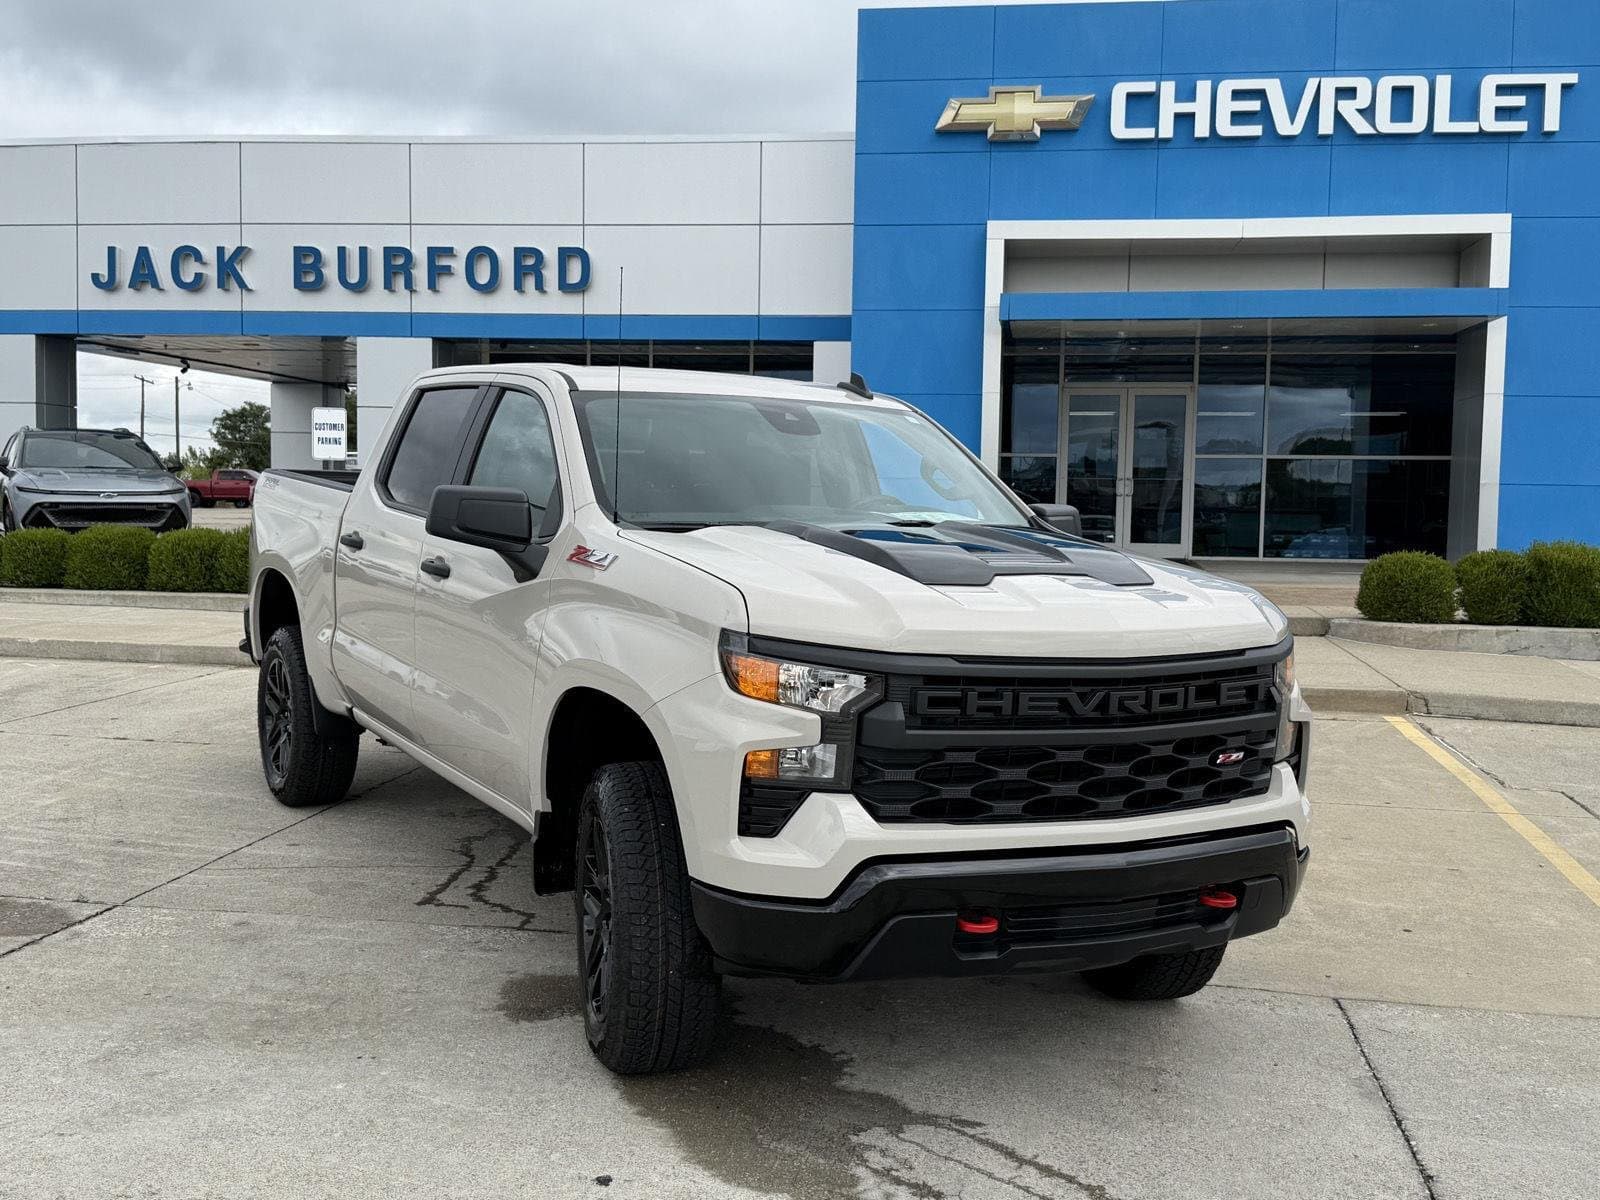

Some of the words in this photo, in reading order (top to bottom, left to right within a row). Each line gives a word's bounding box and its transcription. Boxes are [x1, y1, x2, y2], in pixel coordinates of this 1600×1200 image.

[1110, 73, 1579, 140] CHEVROLET
[91, 245, 251, 291] JACK
[293, 245, 592, 293] BURFORD
[314, 422, 345, 431] CUSTOMER
[317, 436, 342, 445] PARKING
[914, 677, 1271, 717] CHEVROLET
